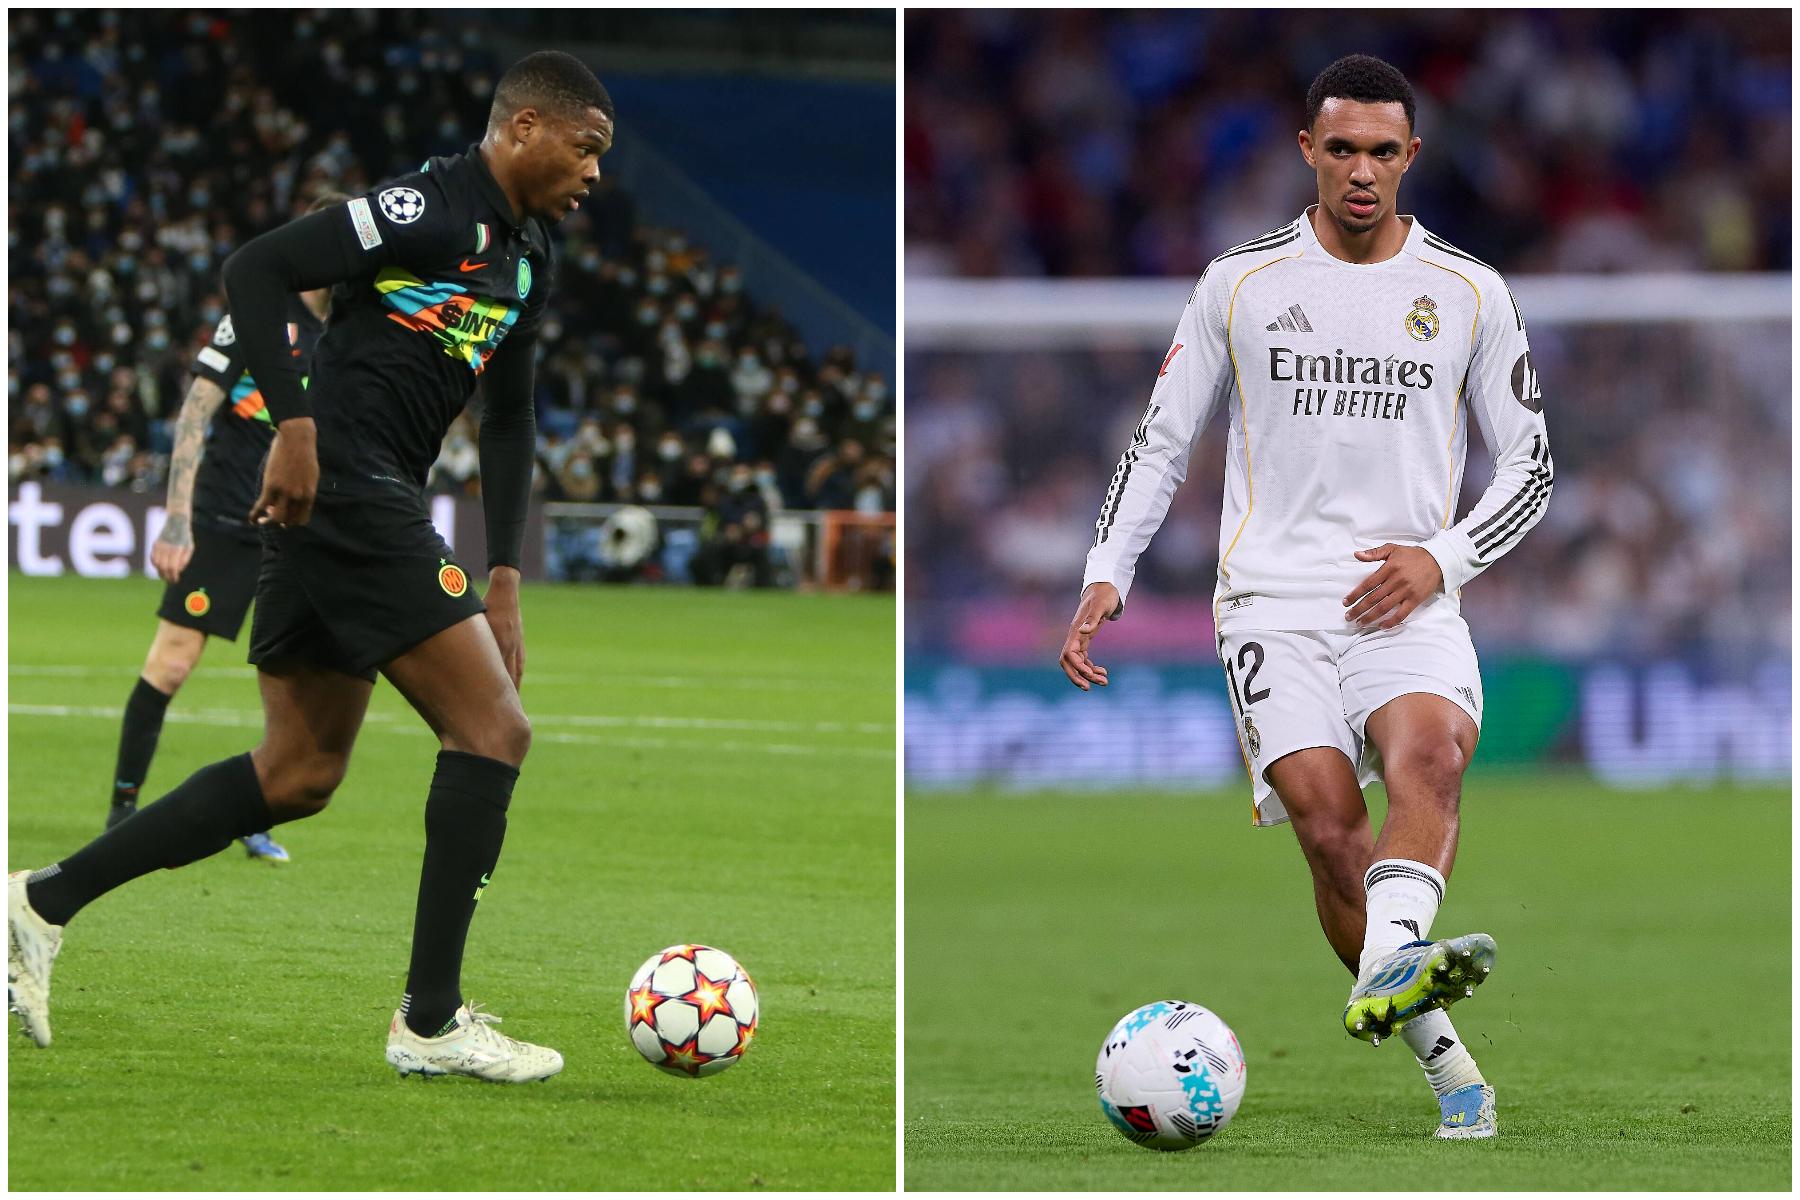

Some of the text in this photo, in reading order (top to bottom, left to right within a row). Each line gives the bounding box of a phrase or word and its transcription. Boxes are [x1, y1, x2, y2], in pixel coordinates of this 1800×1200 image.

[1268, 347, 1434, 389] Emirates
[1292, 388, 1407, 420] FLY BETTER
[1227, 641, 1271, 718] 12
